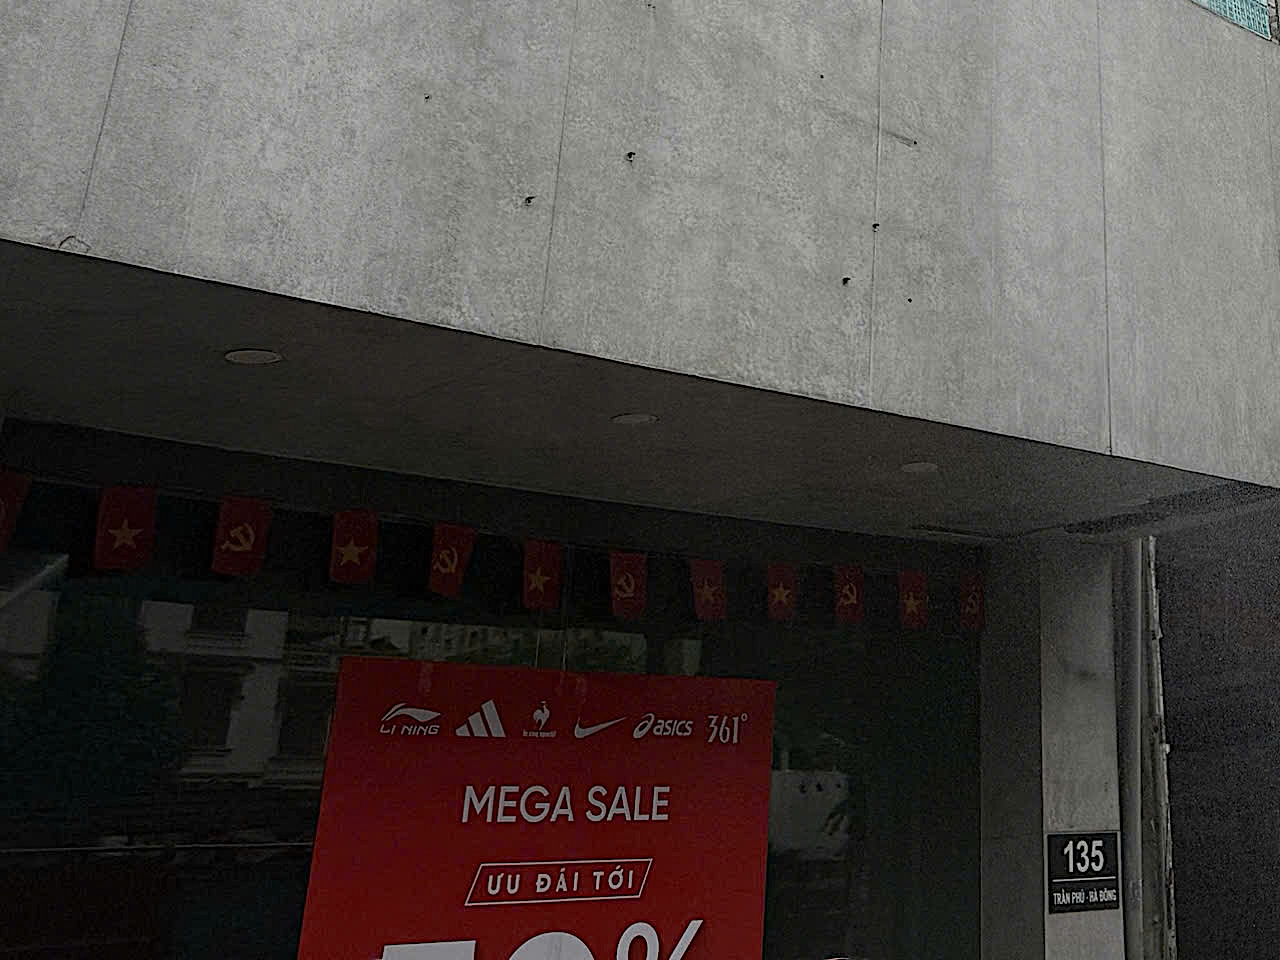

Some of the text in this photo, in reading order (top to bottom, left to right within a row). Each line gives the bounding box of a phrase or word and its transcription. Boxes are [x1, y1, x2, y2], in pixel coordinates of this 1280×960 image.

[400, 724, 440, 736] NING
[461, 784, 671, 824] MEGA SALE
[1063, 839, 1105, 873] 135
[487, 872, 521, 896] ƯU
[592, 865, 634, 891] TỚI
